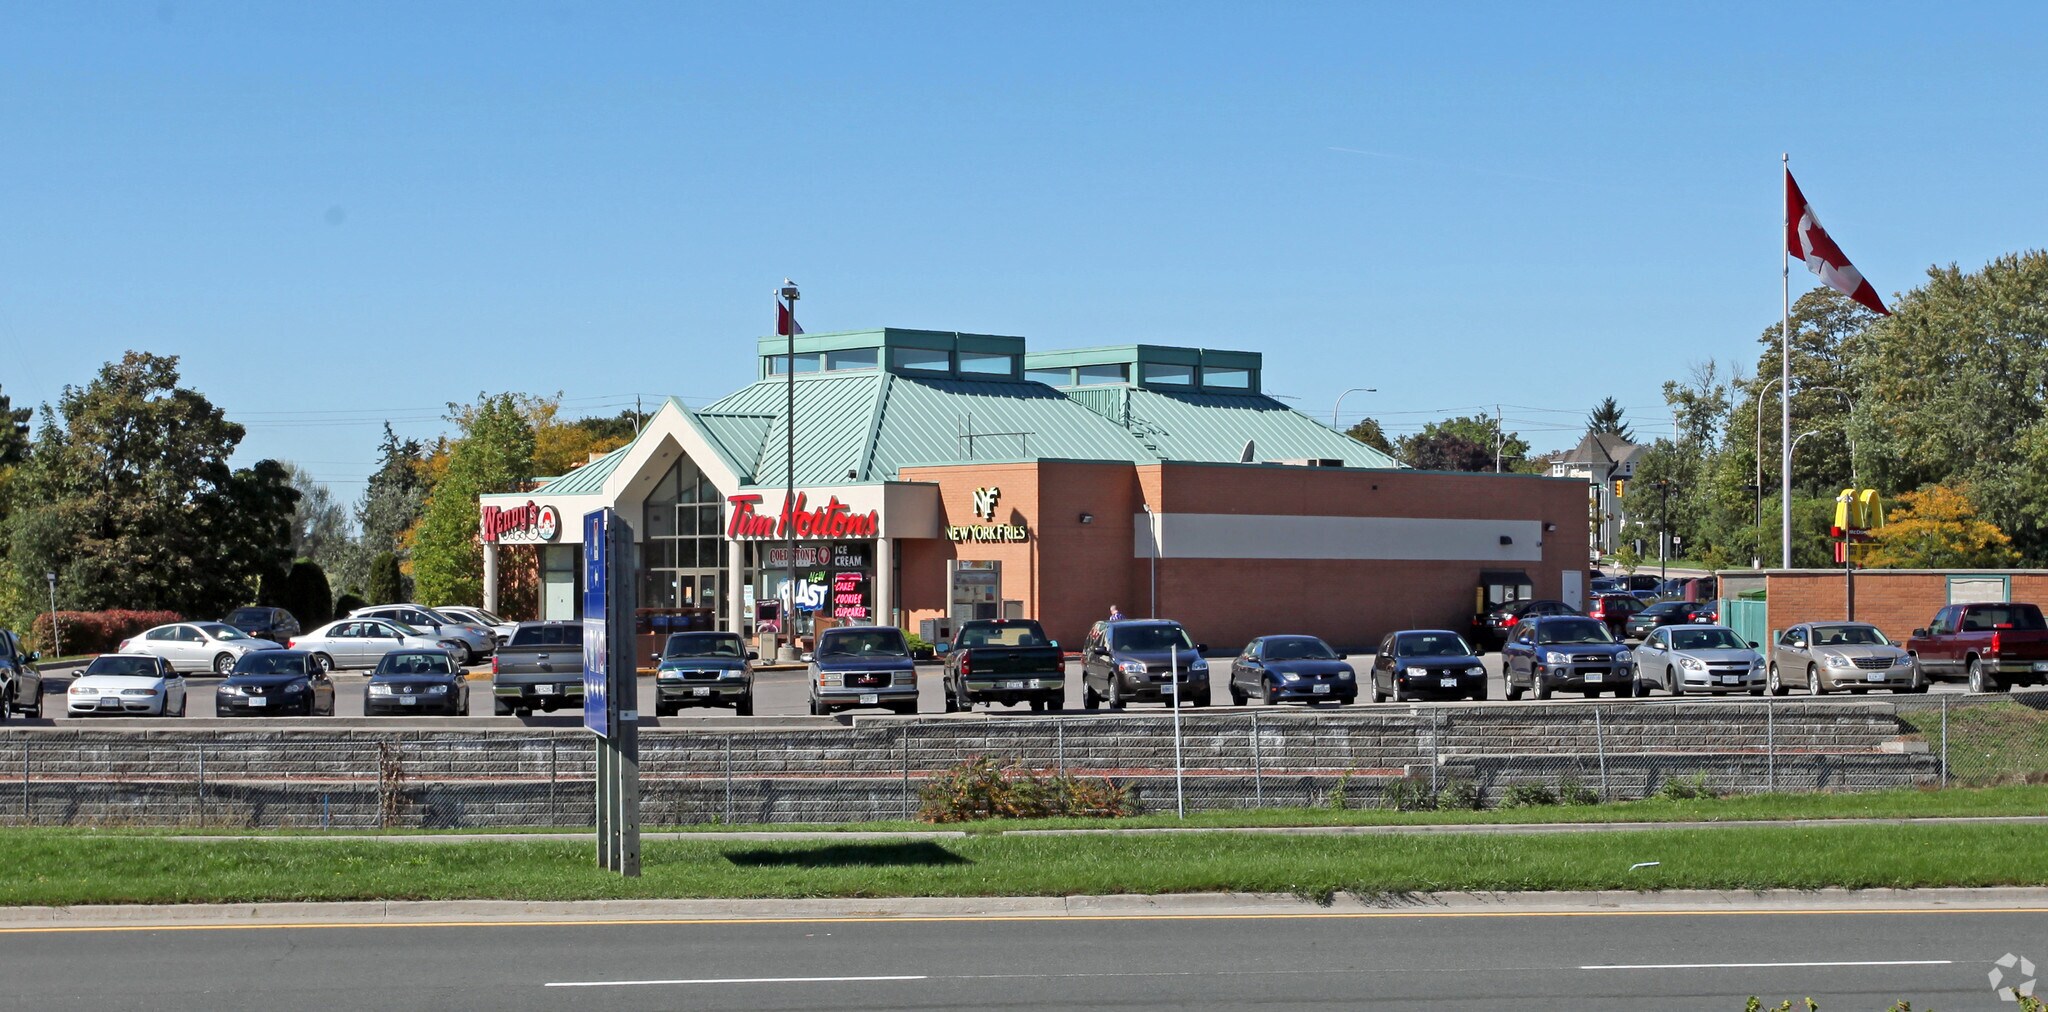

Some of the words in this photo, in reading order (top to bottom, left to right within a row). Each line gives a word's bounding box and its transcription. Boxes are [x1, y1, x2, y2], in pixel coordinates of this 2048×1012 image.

[727, 494, 776, 539] Tim
[776, 490, 878, 538] Hortons
[947, 525, 969, 540] NEW
[969, 524, 997, 540] YORK
[997, 524, 1026, 540] FRIES
[835, 546, 847, 554] ICE
[792, 548, 817, 564] TONE
[835, 556, 862, 567] CREAM
[808, 571, 826, 583] NEW
[835, 582, 856, 591] CAKES
[835, 594, 863, 604] COOKIES
[835, 607, 867, 617] CUPCAKES
